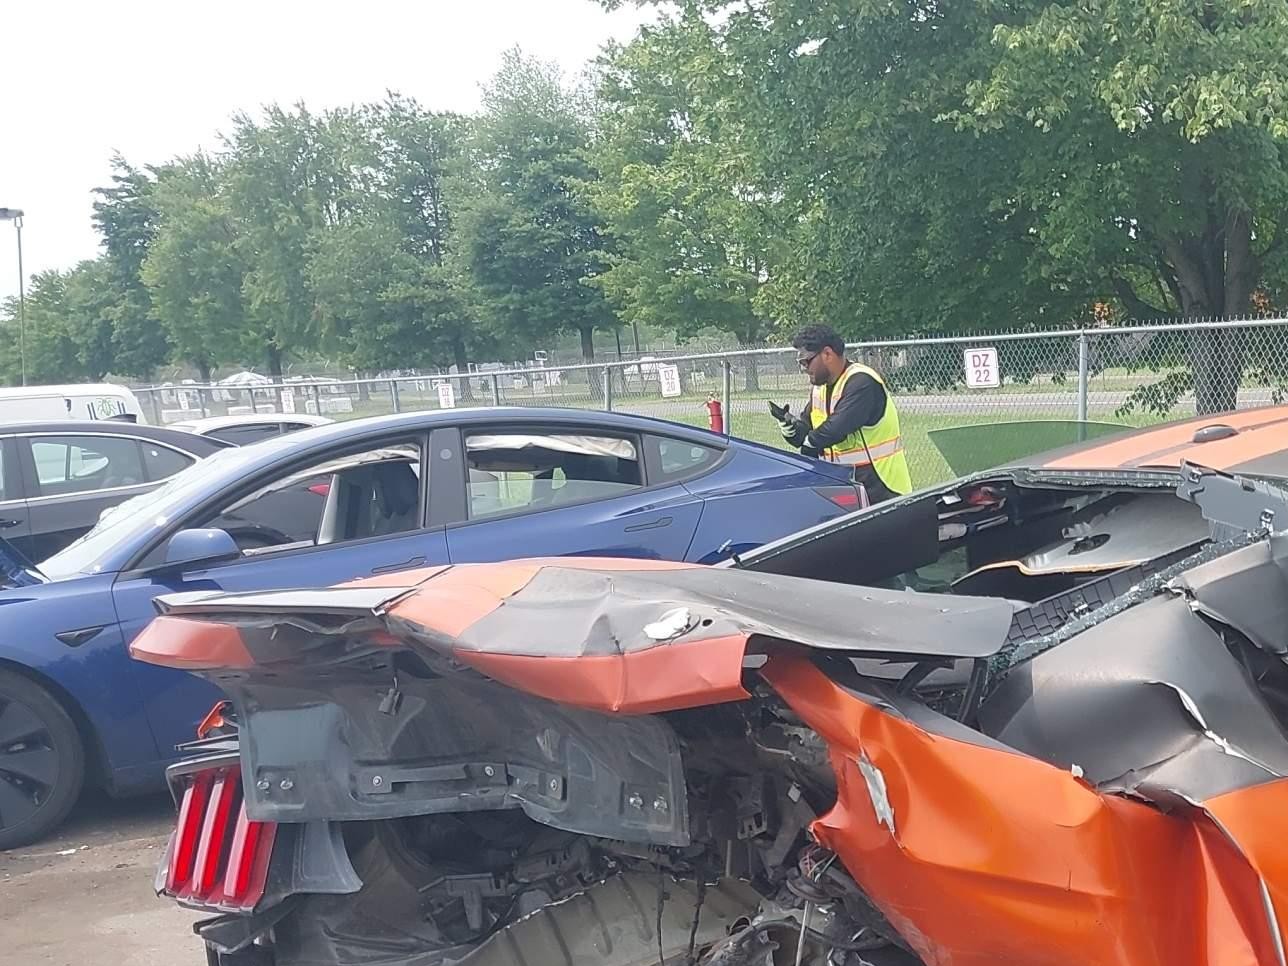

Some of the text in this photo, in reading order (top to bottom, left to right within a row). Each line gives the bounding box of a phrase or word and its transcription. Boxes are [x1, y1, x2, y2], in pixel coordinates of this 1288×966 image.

[972, 354, 991, 368] DZ
[663, 369, 676, 381] DZ
[975, 369, 992, 382] 22
